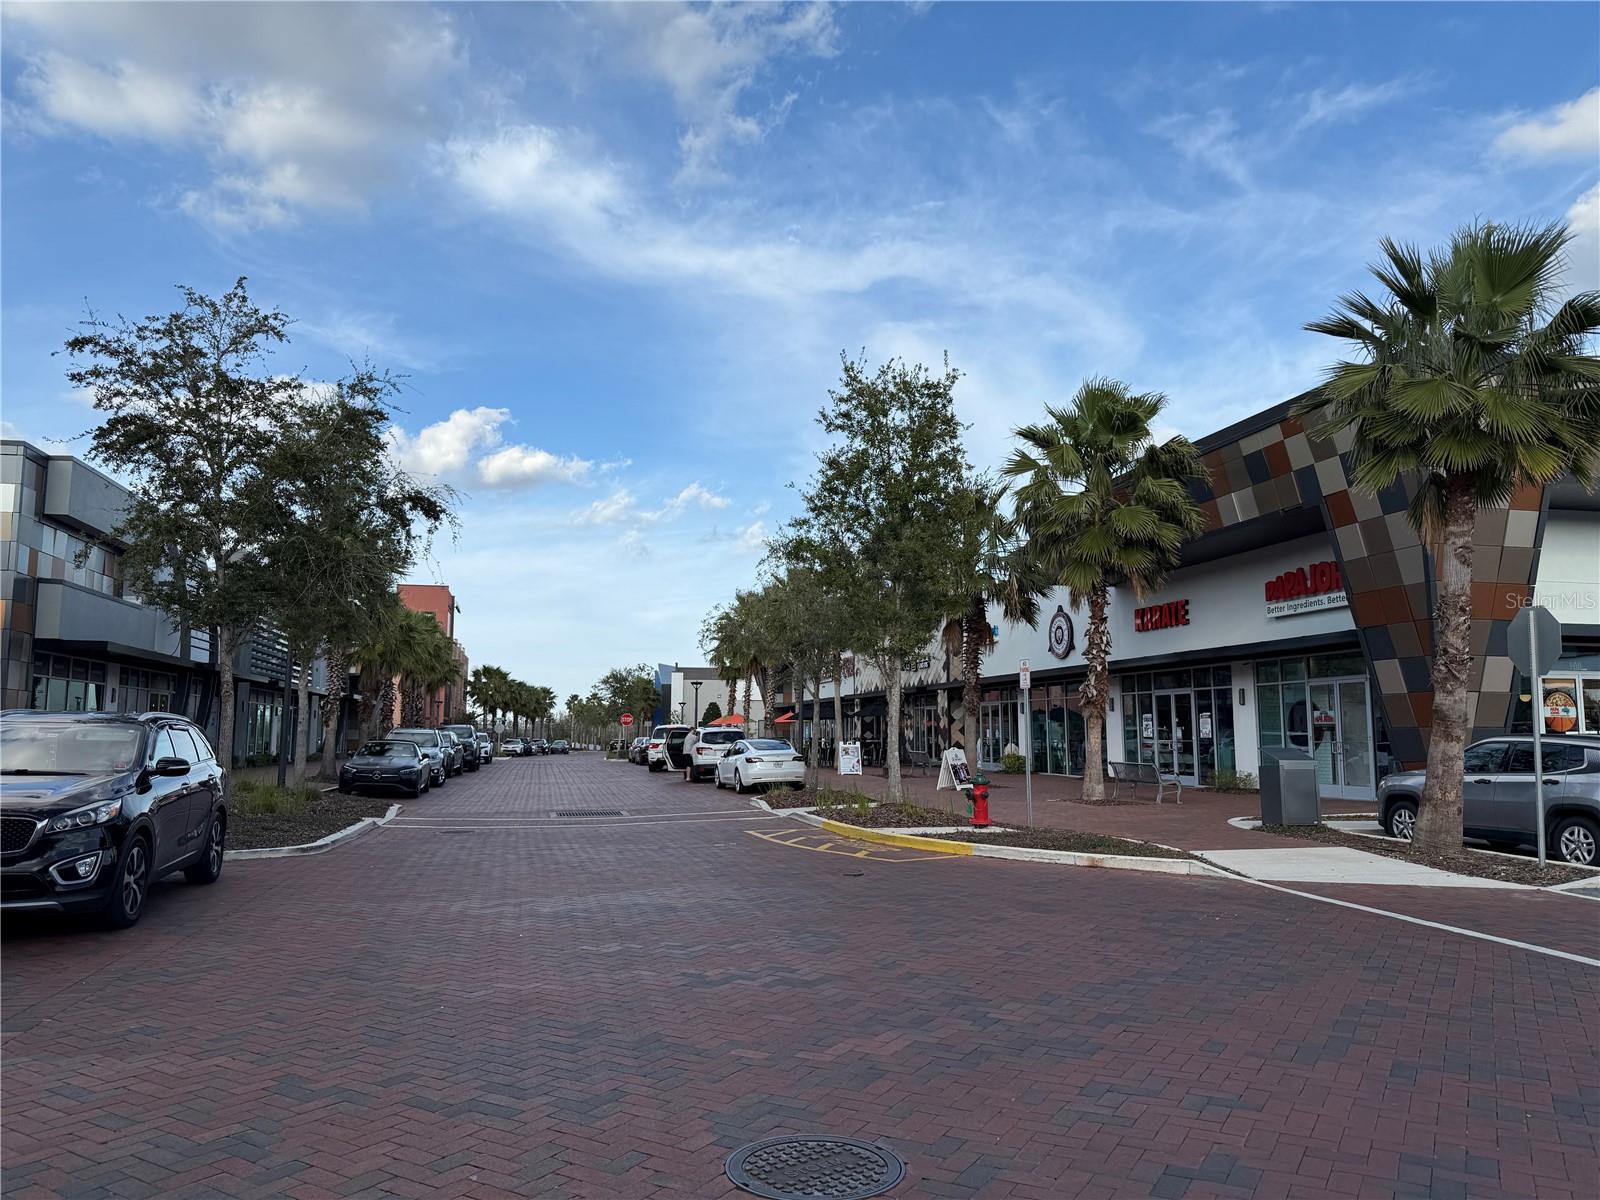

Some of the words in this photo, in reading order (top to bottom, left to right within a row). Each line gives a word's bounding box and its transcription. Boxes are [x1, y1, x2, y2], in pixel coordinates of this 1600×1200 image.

[1265, 567, 1307, 601] PAPA
[1135, 599, 1190, 632] KARATE
[1266, 604, 1286, 615] Better
[1286, 597, 1326, 612] Ingredients.
